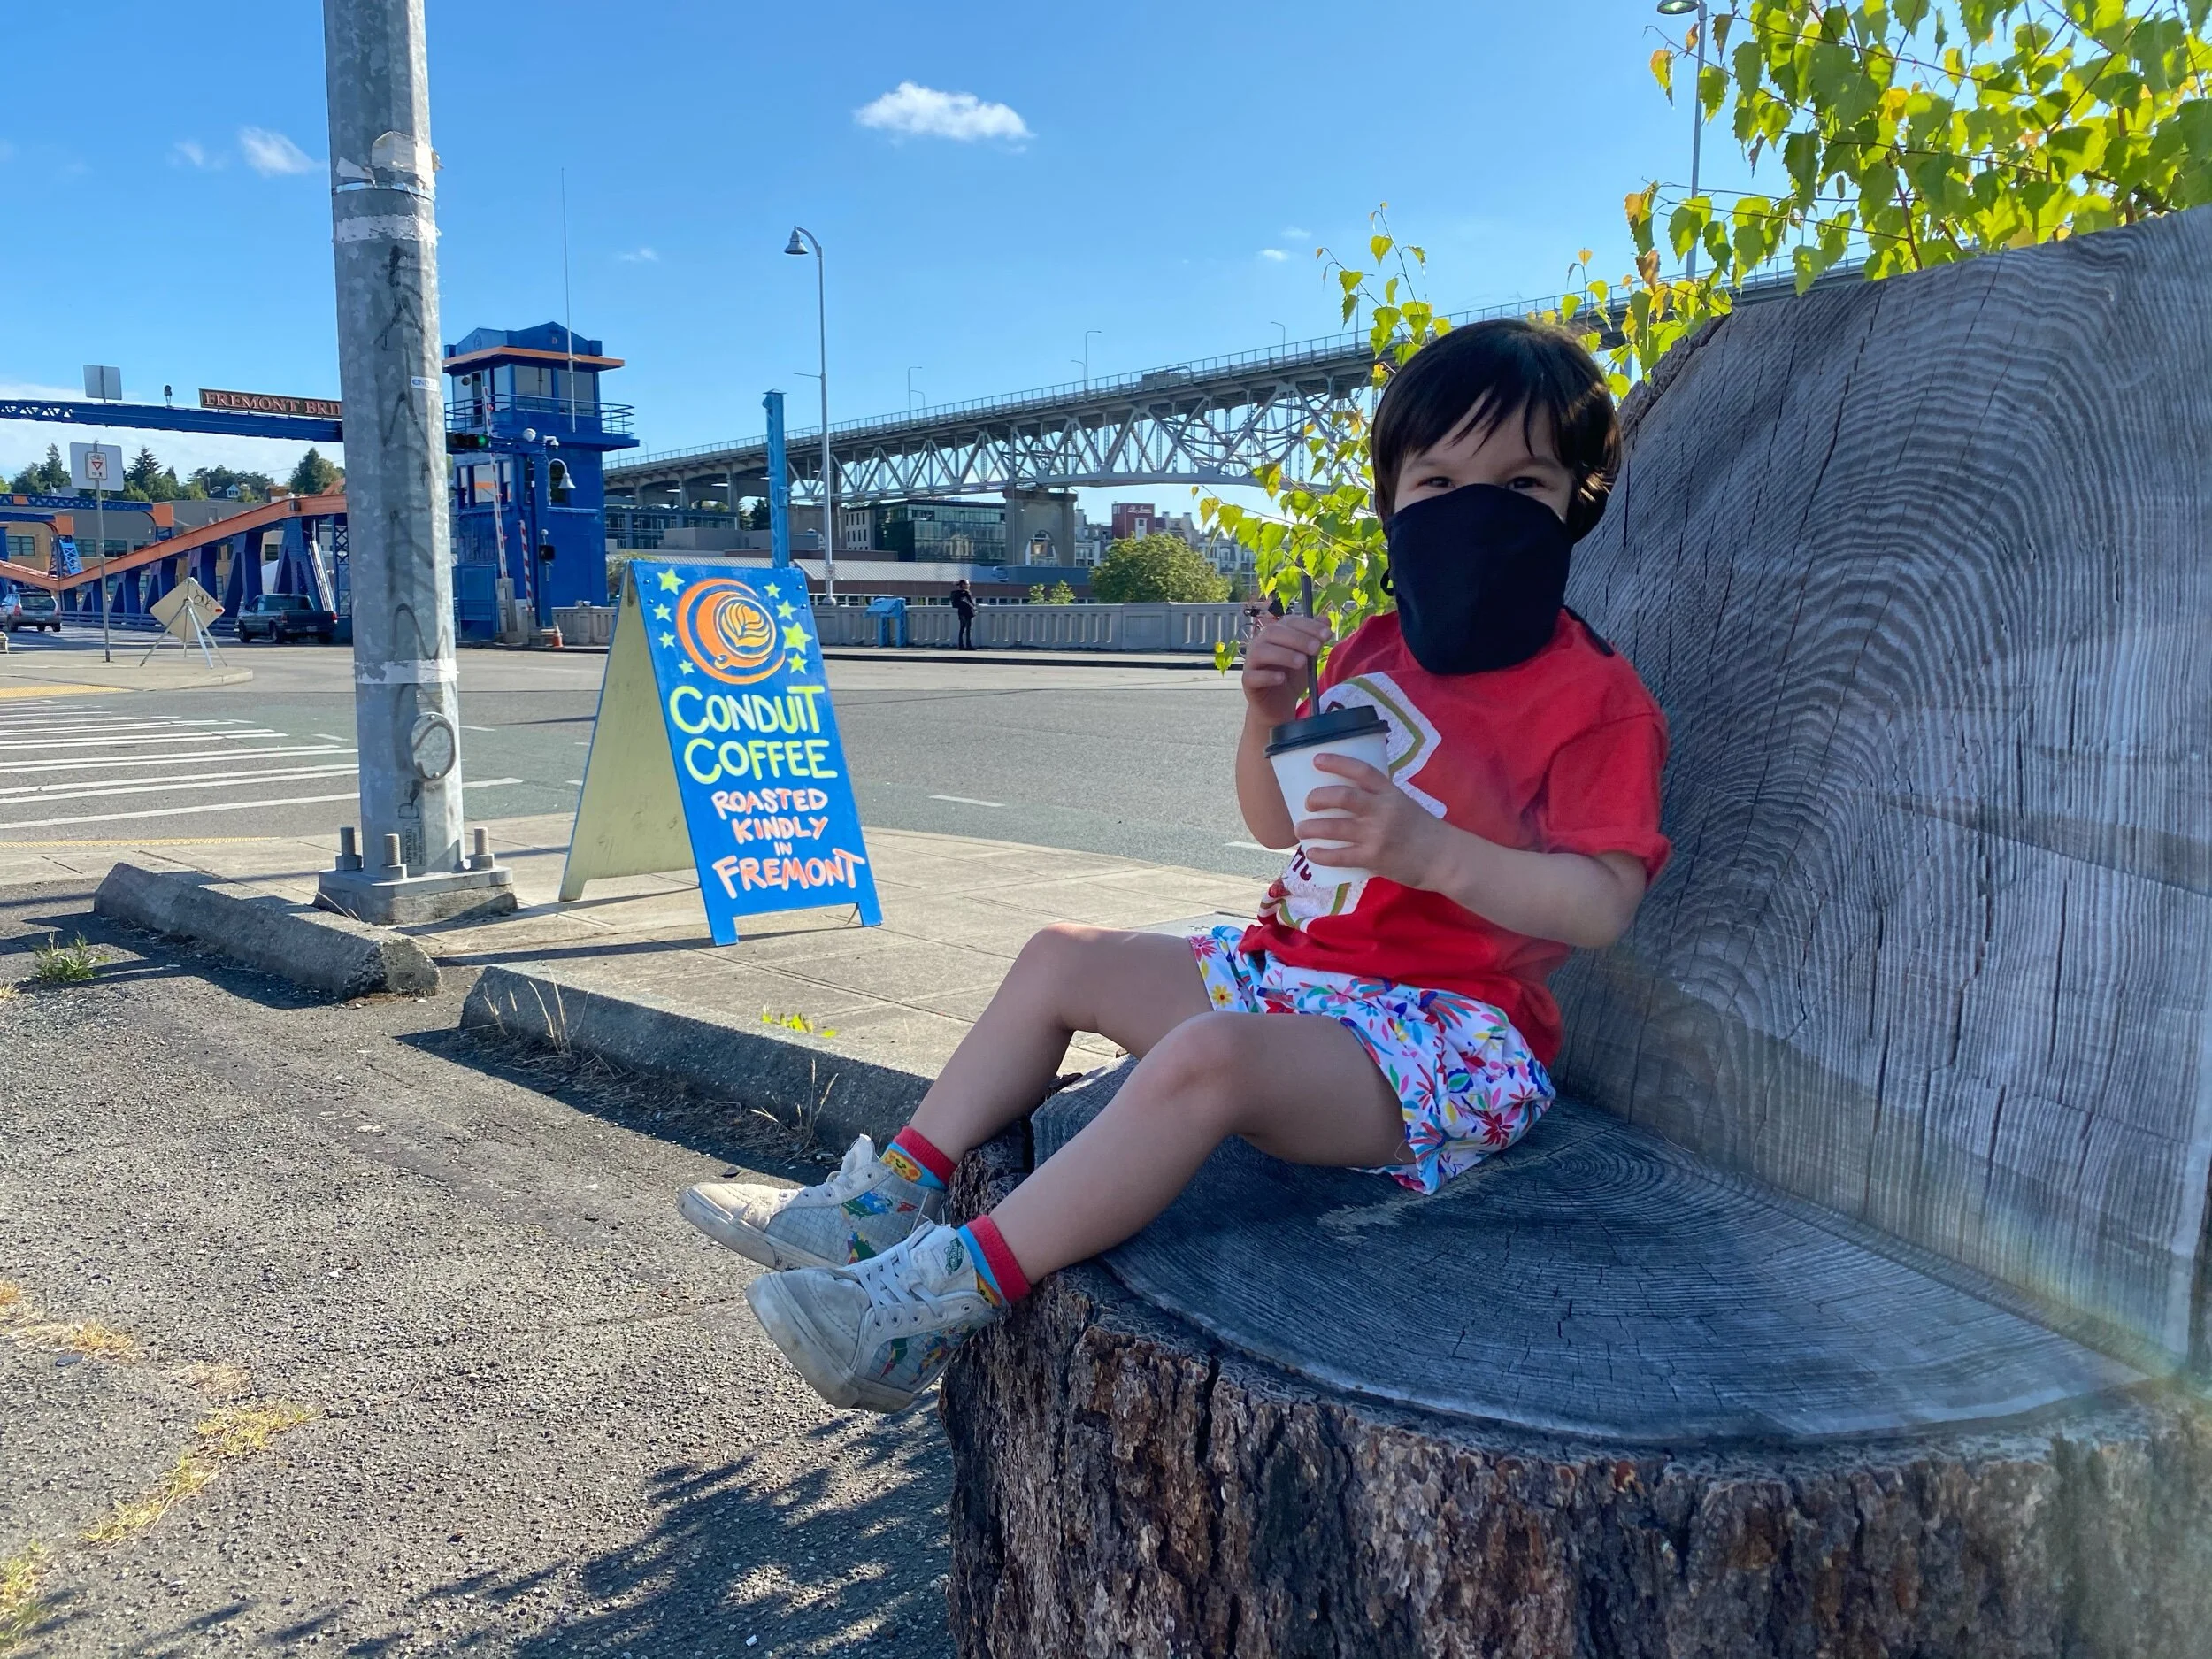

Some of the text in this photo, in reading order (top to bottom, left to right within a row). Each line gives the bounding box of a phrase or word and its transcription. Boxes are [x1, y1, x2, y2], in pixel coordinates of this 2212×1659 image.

[204, 392, 342, 415] FREMONT BRI
[670, 685, 825, 734] CONDUIT
[684, 738, 838, 784] COFFEE
[711, 787, 828, 819] ROASTED
[732, 816, 828, 844] KINDLY
[774, 841, 793, 856] IN
[712, 848, 865, 899] FREMONT
